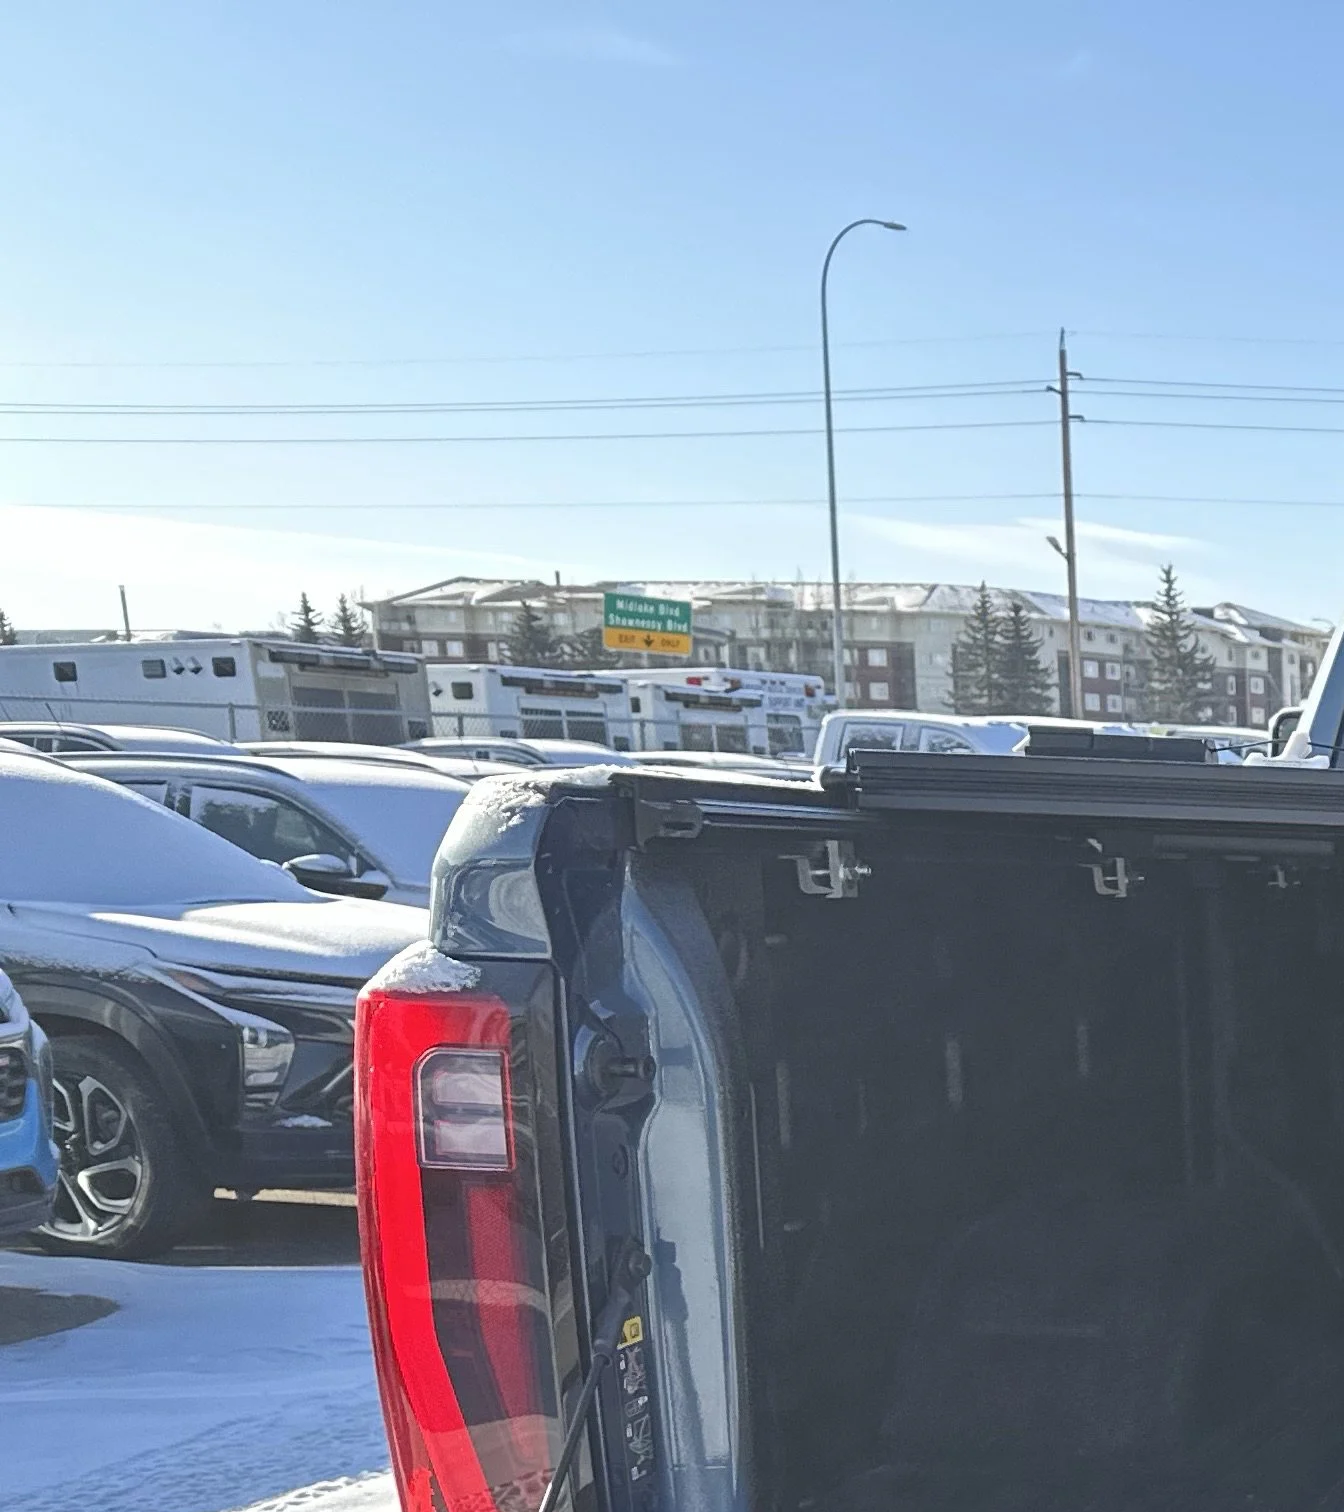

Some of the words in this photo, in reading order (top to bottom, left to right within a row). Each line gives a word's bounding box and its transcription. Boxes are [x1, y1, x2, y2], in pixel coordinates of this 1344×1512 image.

[616, 599, 655, 614] Midlake
[658, 603, 681, 617] Blvd
[608, 613, 663, 632] Shawnessy
[666, 619, 688, 633] Blvd
[618, 634, 636, 644] EXIT
[661, 638, 680, 648] ONLY
